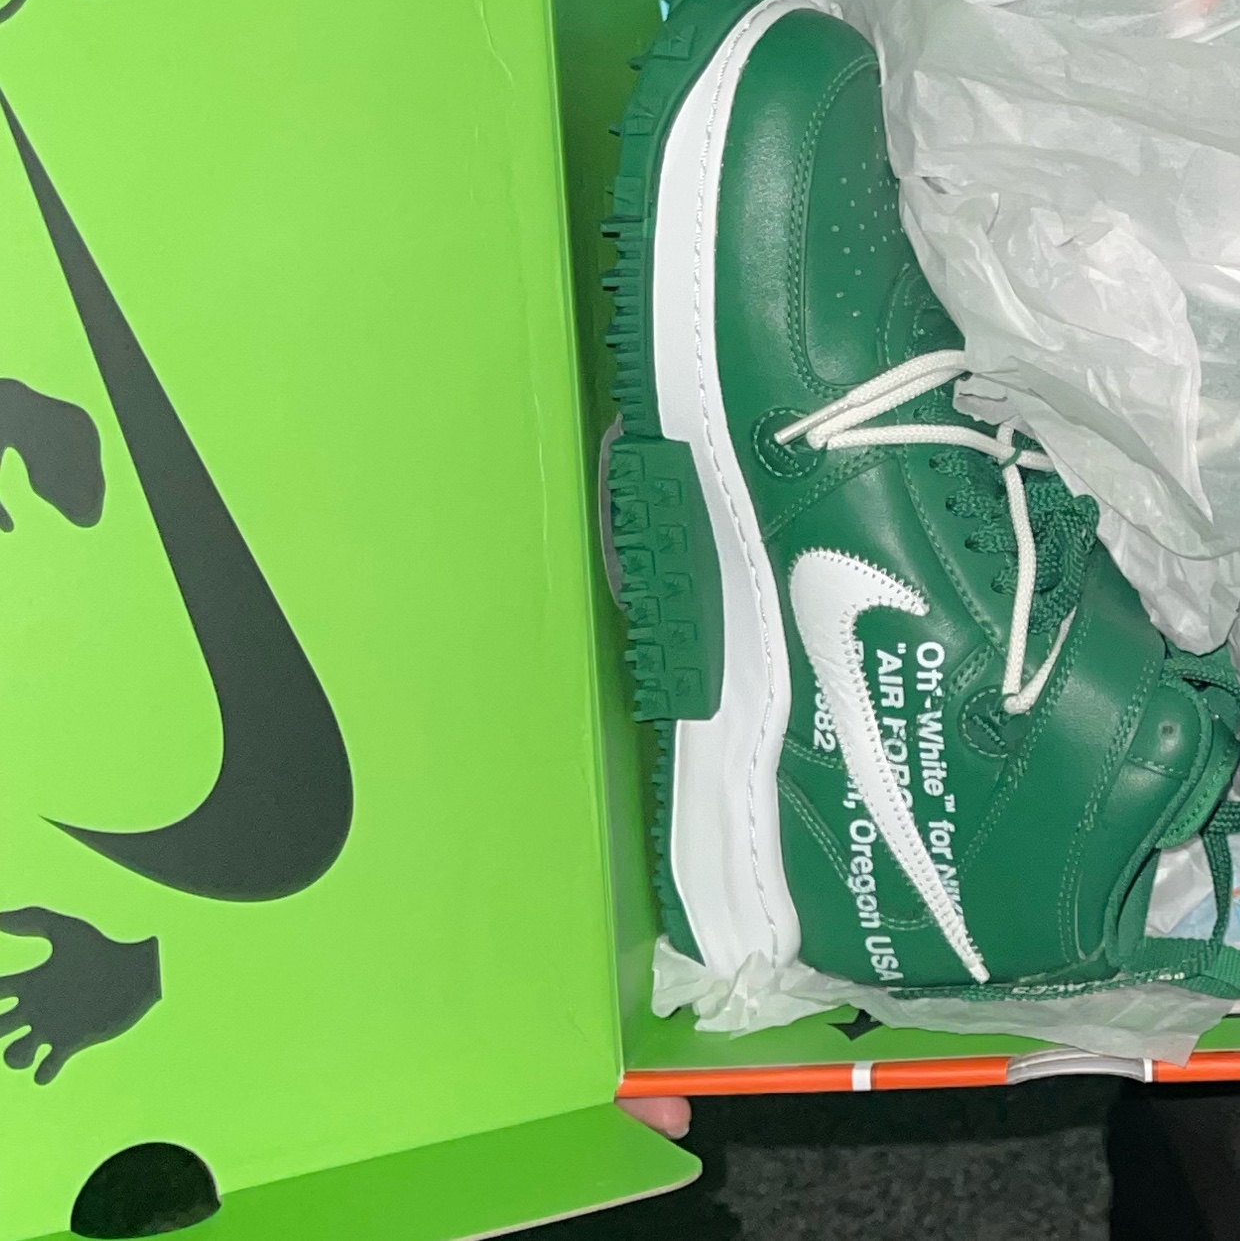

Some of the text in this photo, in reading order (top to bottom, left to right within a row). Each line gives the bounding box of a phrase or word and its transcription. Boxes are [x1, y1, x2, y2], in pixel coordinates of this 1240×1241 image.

[927, 819, 957, 860] for
[848, 818, 881, 930] Oregon
[864, 935, 904, 983] USA
